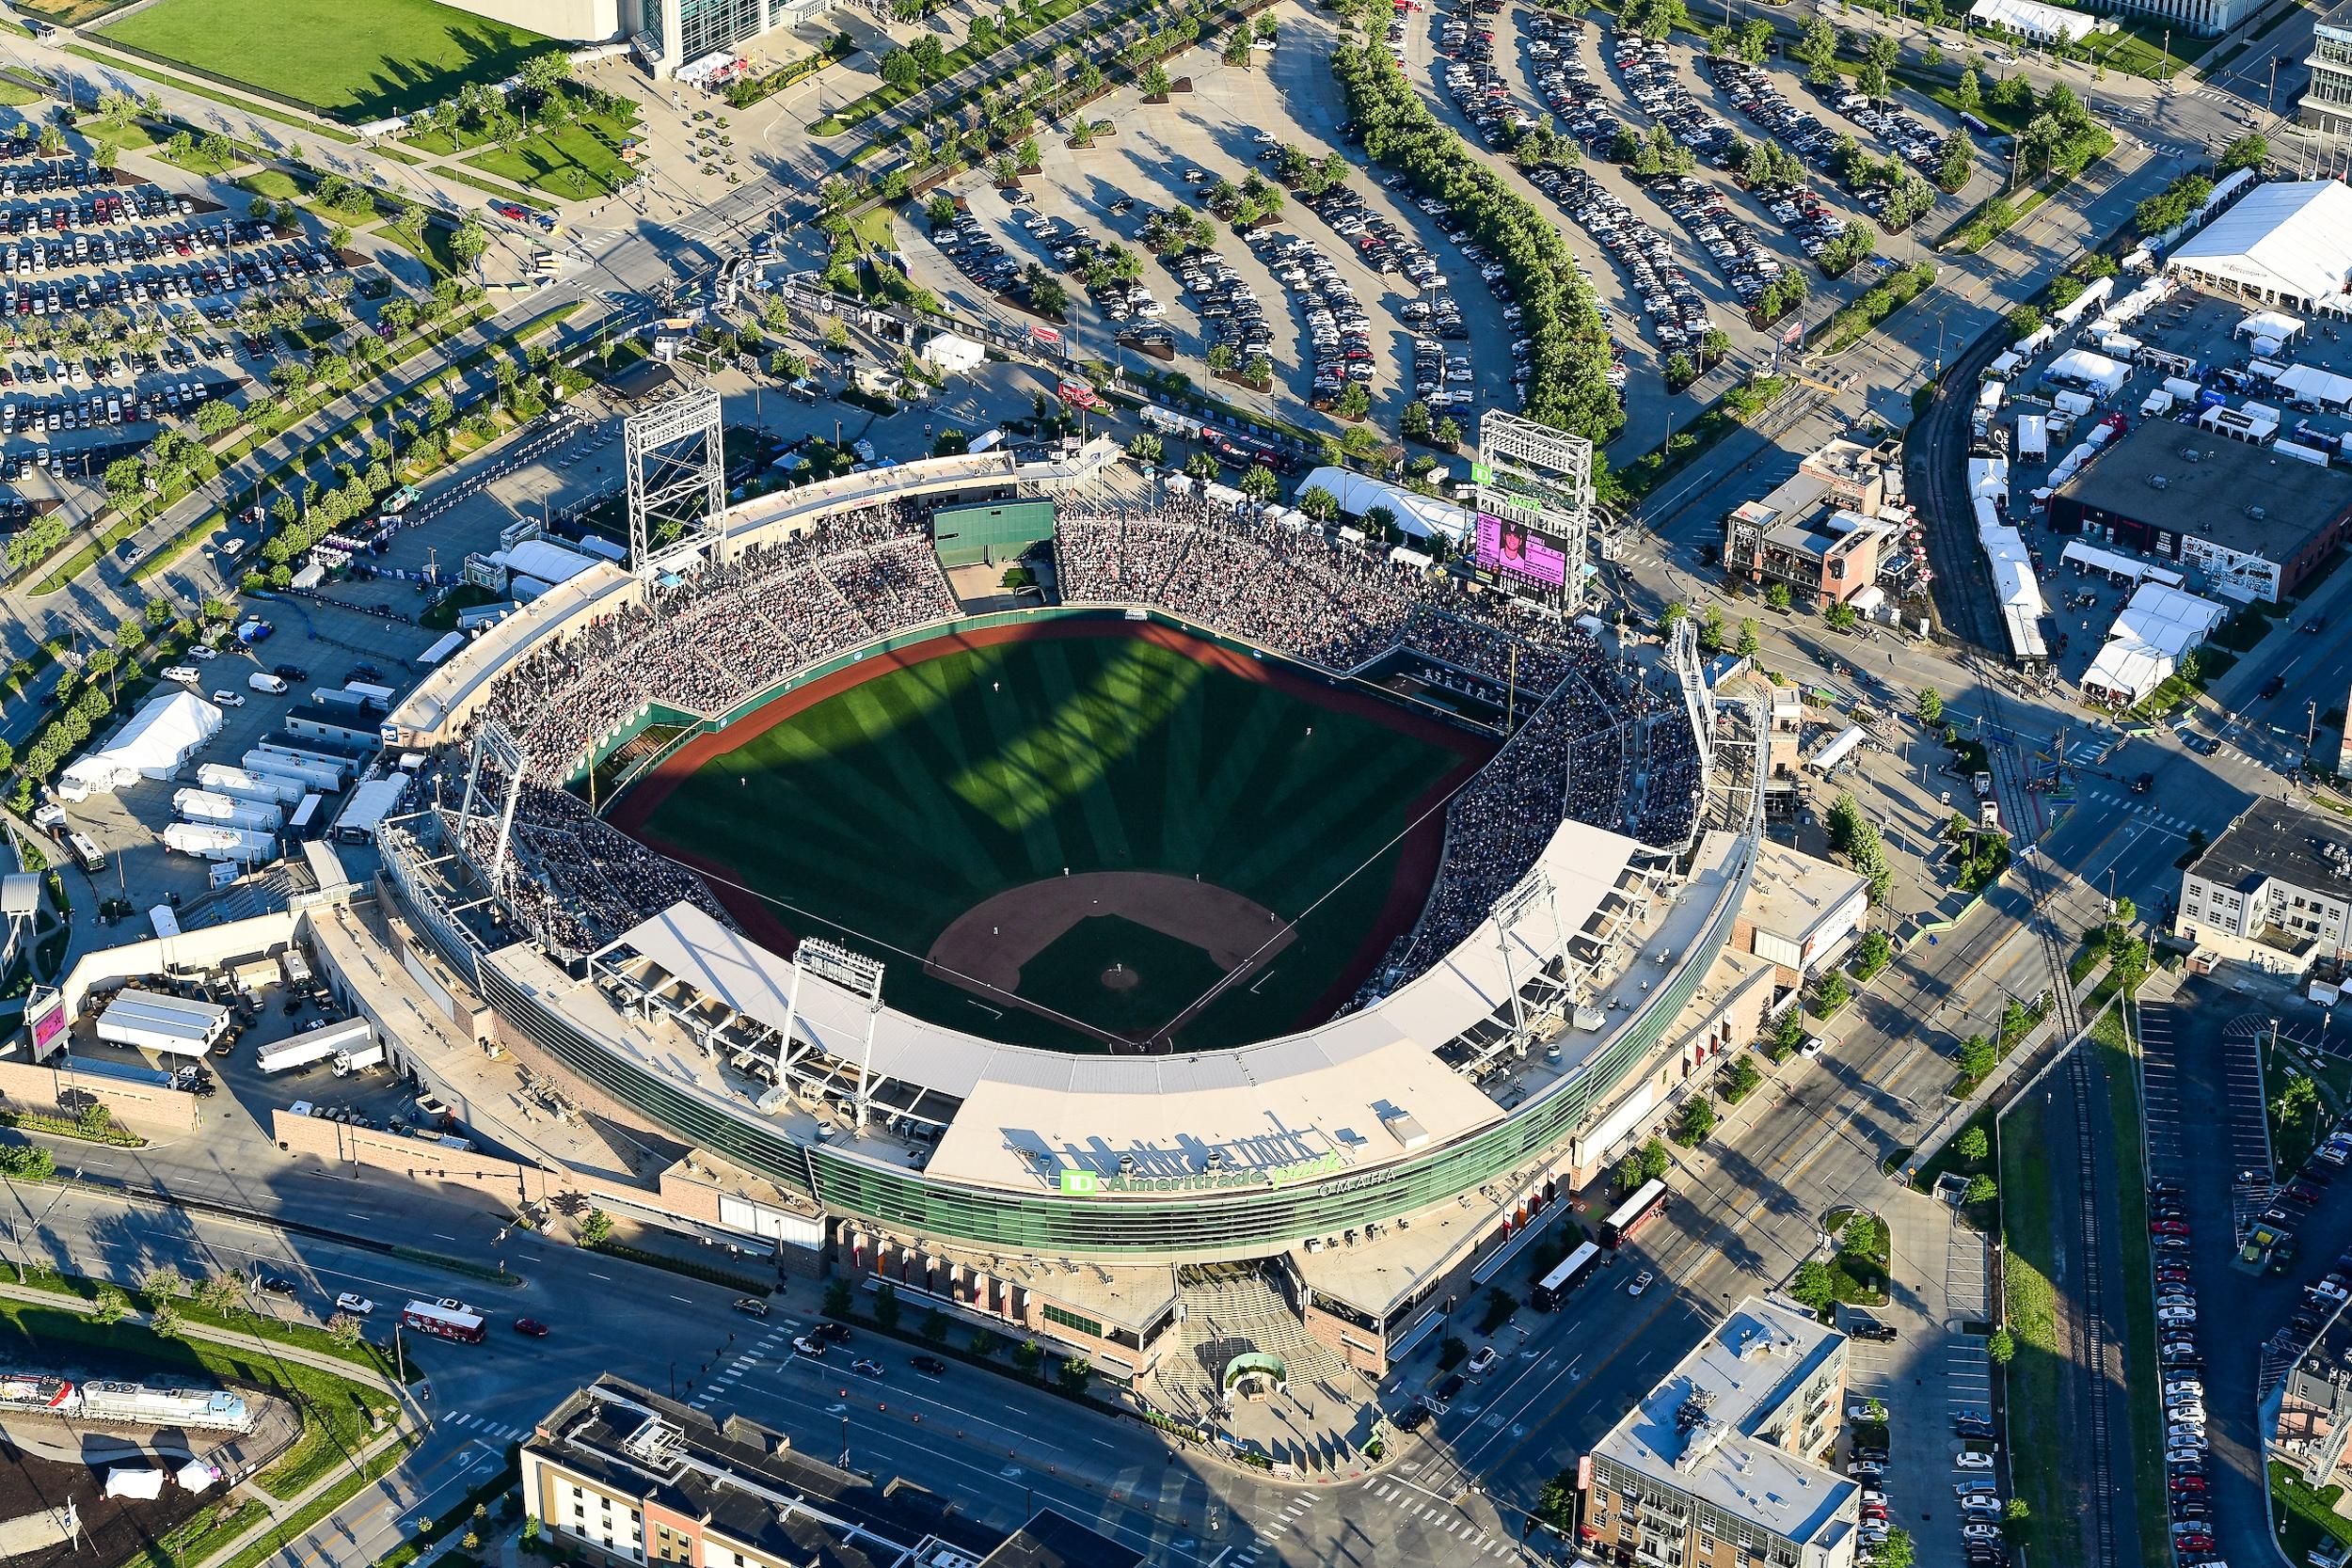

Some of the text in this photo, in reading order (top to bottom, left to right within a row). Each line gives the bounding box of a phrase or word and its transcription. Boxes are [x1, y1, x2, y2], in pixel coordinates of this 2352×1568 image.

[1064, 1148, 1341, 1192] TD Ameritrade park
[1319, 1169, 1395, 1196] OMAHA
